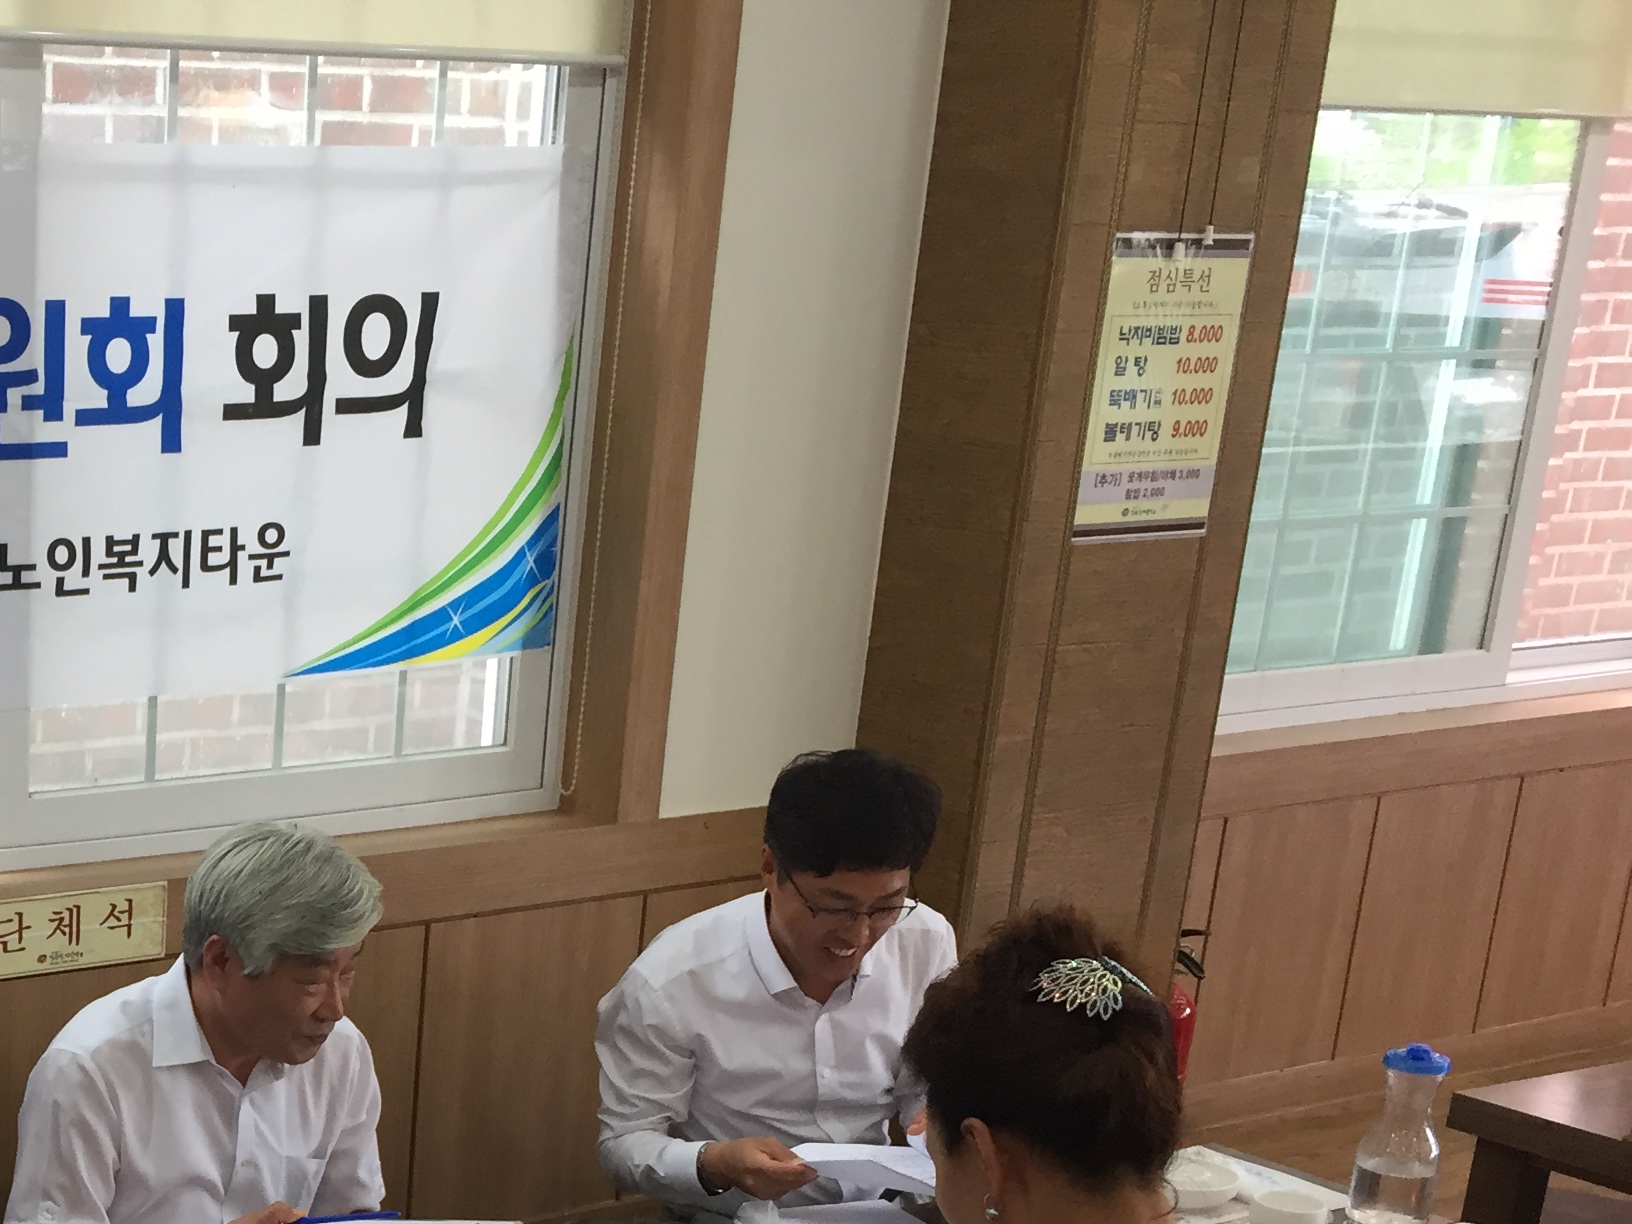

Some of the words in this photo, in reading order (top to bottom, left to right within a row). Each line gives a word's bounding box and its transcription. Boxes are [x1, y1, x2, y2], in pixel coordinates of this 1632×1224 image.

[1147, 266, 1212, 294] 점심특선
[1118, 324, 1183, 346] 낙지비빔밥
[1186, 324, 1224, 344] 8.000
[223, 291, 440, 445] 회의
[1176, 356, 1218, 374] 10.000
[1171, 388, 1213, 405] 10.000
[1171, 419, 1208, 438] 9.000
